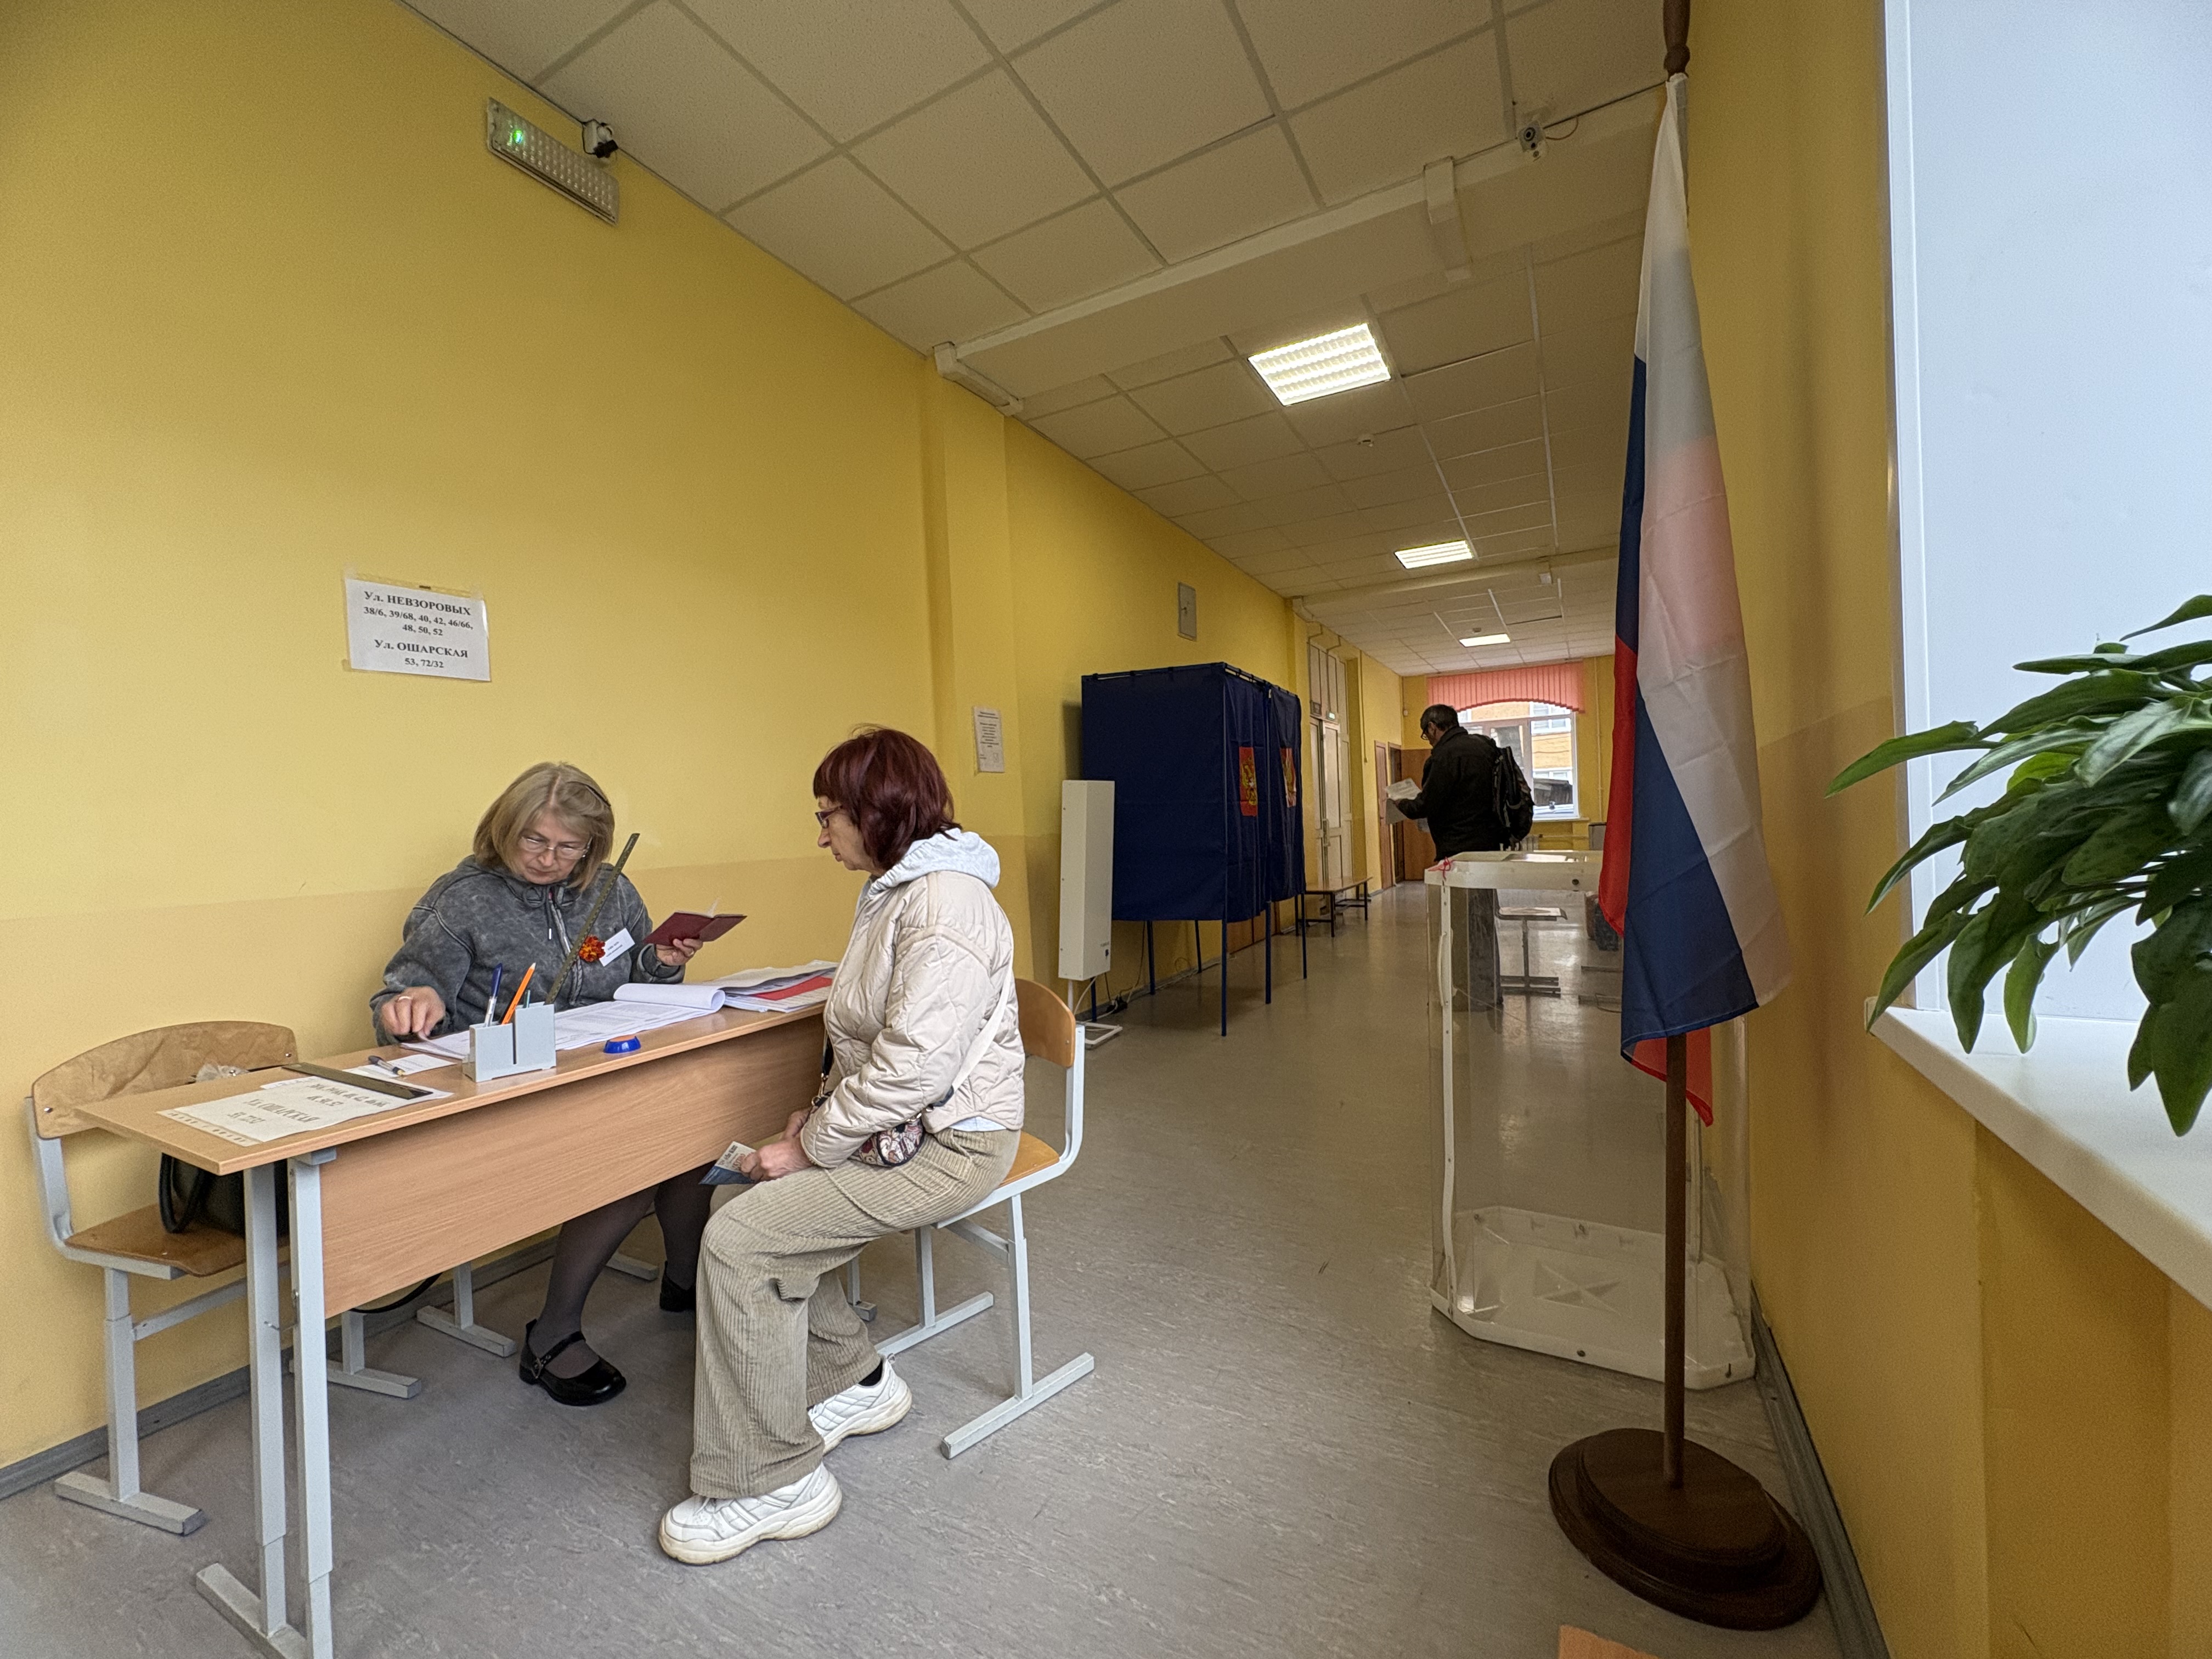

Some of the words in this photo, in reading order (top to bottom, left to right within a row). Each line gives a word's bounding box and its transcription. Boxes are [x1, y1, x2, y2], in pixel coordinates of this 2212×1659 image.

[364, 591, 383, 602] Ул.
[387, 595, 471, 616] НЕВЗОРОВЫХ
[364, 607, 387, 618] 38/6,
[389, 610, 416, 622] 39/68,
[418, 615, 432, 624] 40,
[433, 617, 446, 626] 42,
[448, 619, 473, 630] 46/66,
[402, 624, 416, 633] 48,
[418, 626, 431, 635] 50,
[374, 639, 394, 650] Ул.
[397, 642, 468, 658] ОШАРСКАЯ
[404, 658, 419, 667] 53,
[420, 659, 444, 668] 72/32
